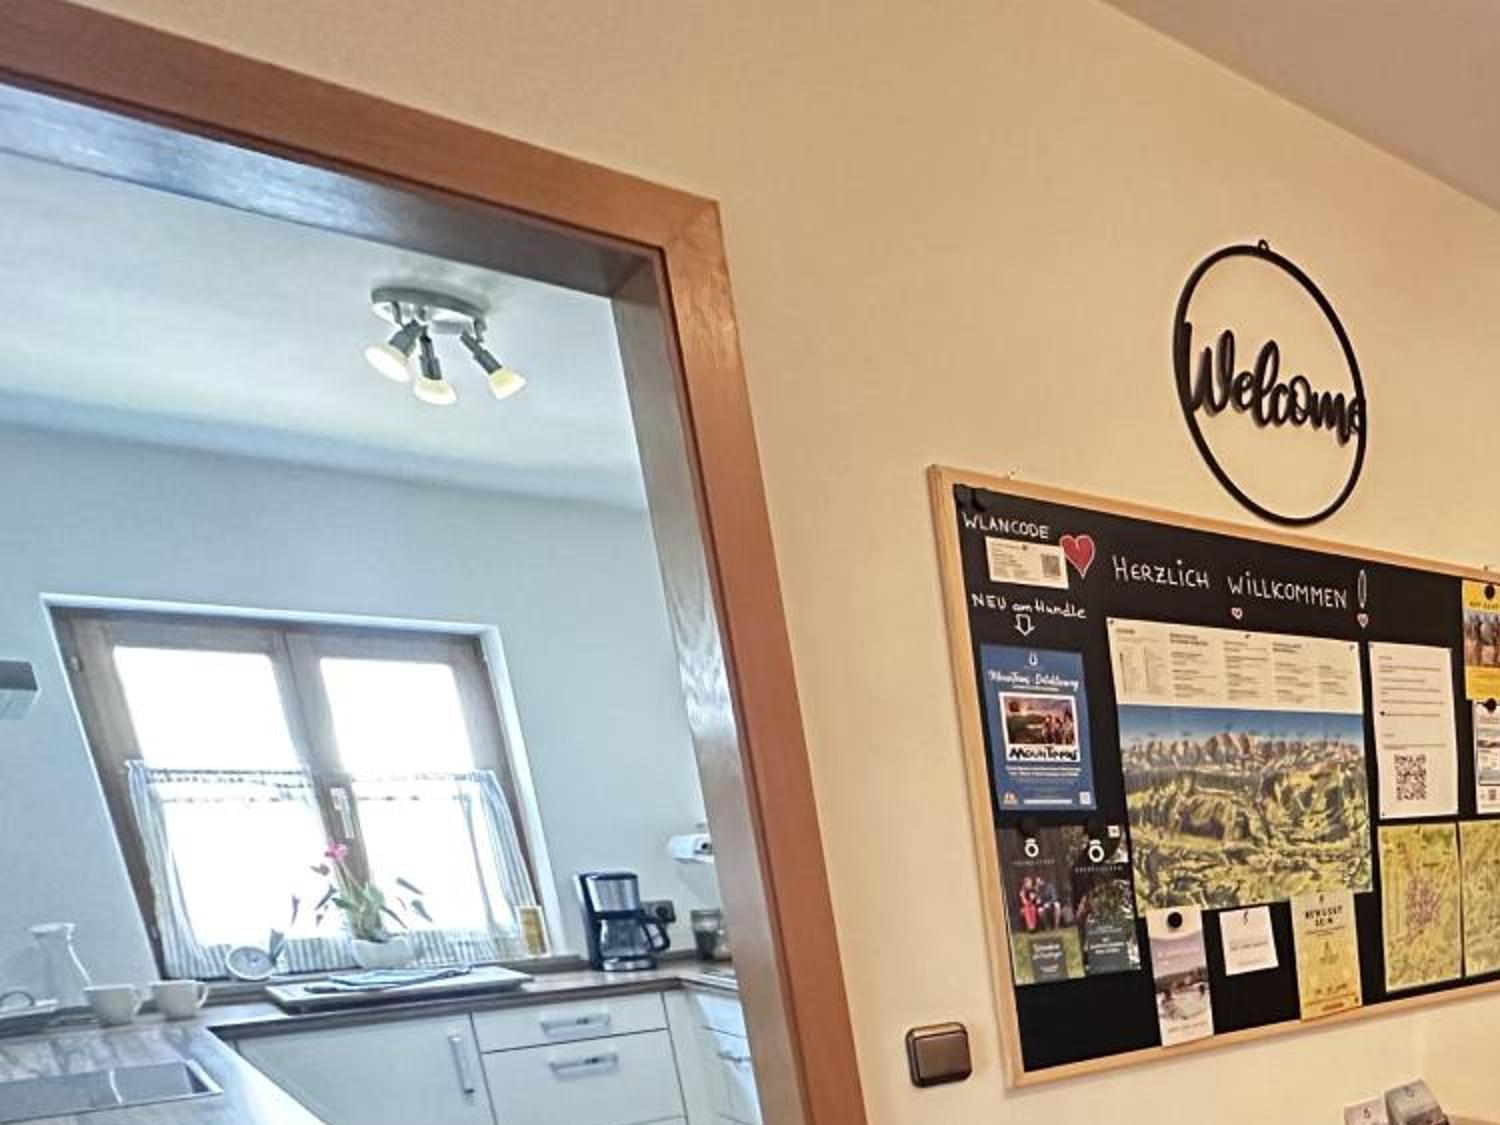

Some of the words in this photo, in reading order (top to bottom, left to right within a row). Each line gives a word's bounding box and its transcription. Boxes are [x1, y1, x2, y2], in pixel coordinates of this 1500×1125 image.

[1177, 321, 1366, 446] Welcome
[962, 511, 1050, 539] WLANCODE
[971, 593, 1007, 610] NEU
